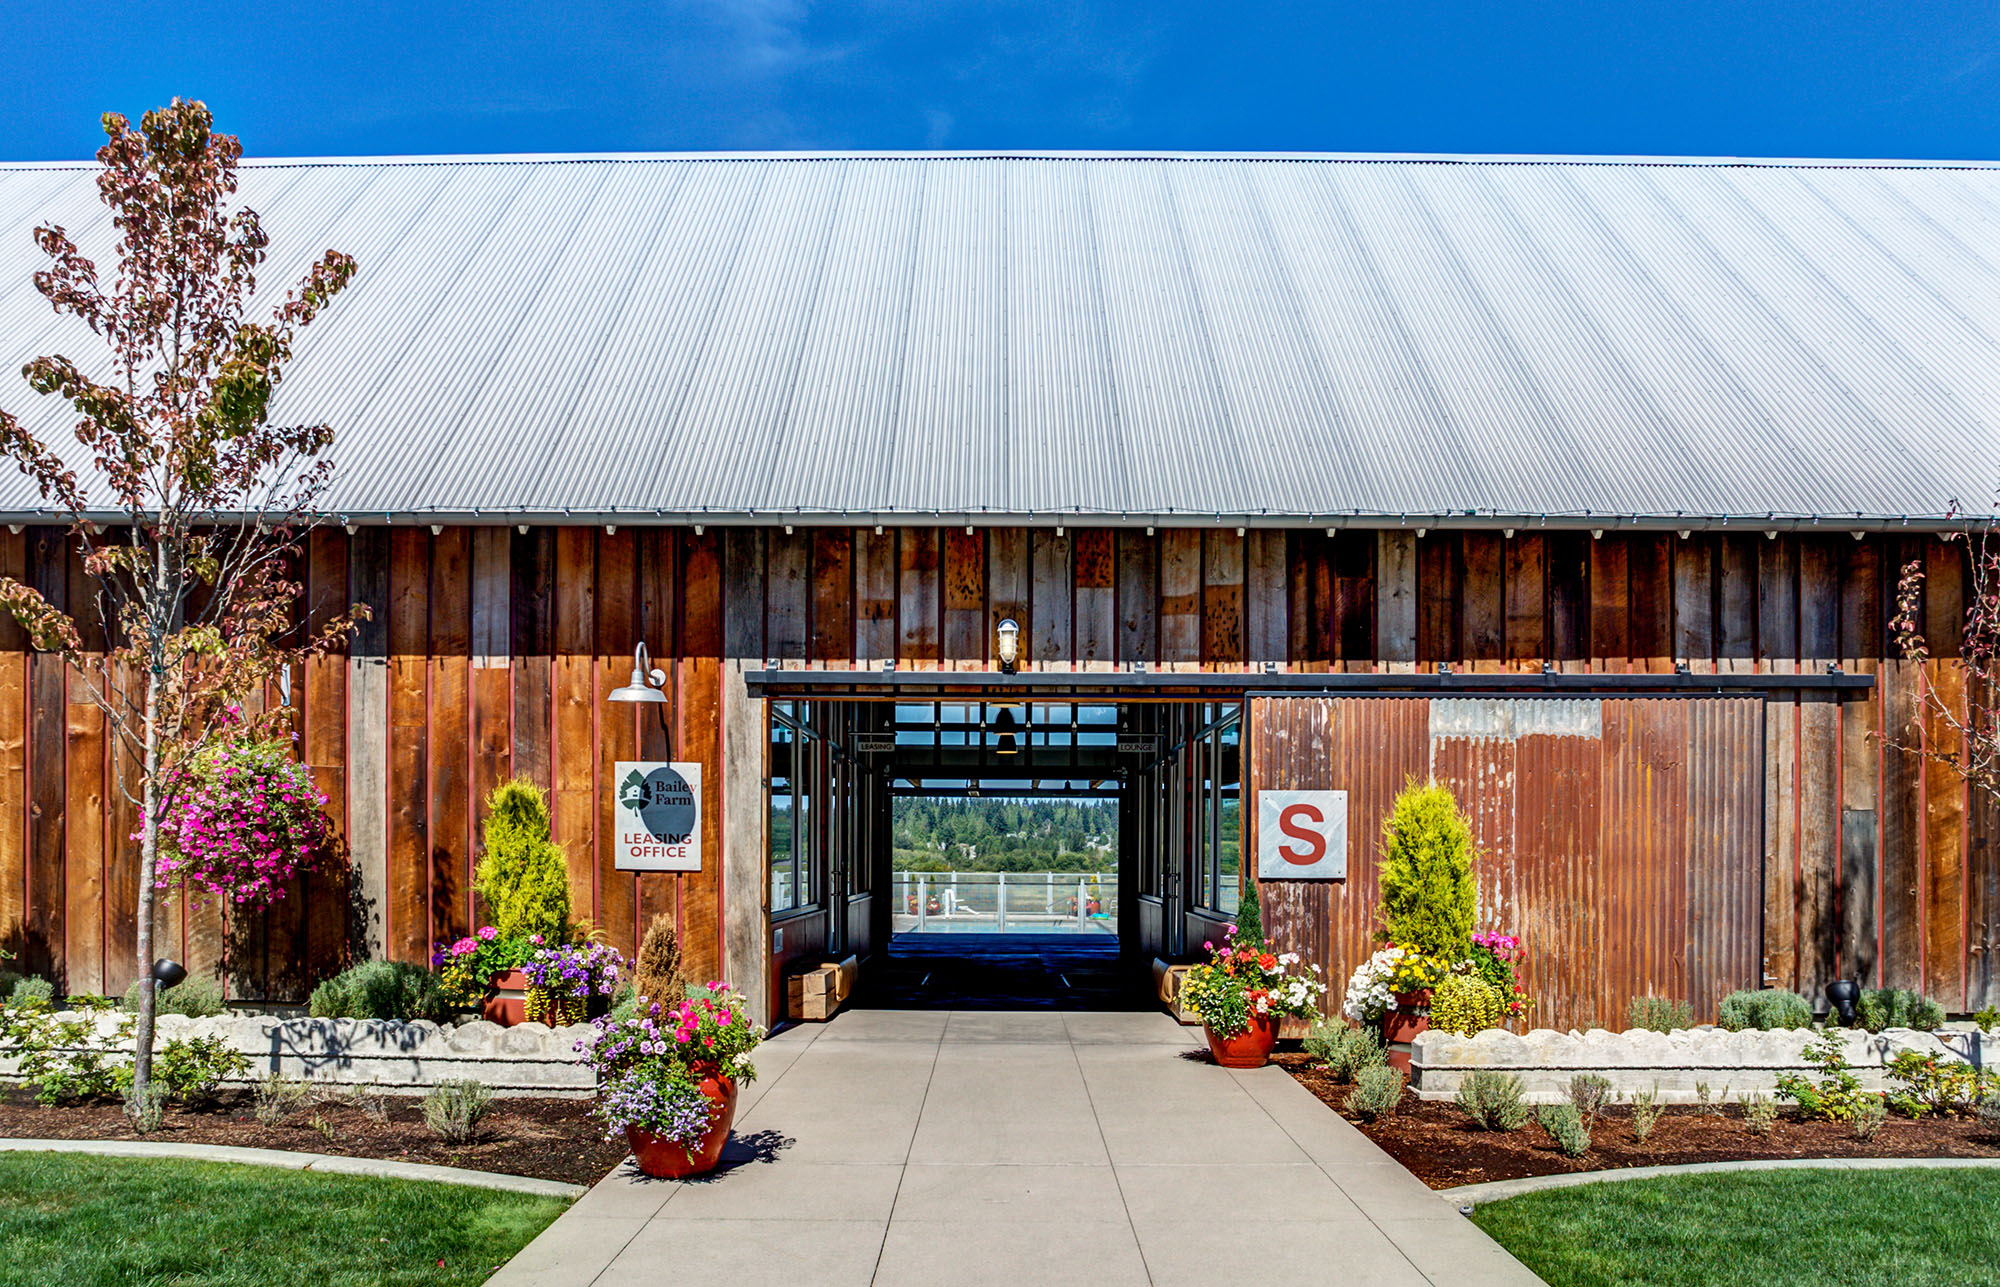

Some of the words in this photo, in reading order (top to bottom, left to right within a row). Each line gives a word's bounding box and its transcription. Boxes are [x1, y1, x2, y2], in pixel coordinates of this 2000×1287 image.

[656, 781, 697, 795] Bailey
[656, 794, 691, 806] Farm
[624, 833, 692, 845] LEASING
[1278, 803, 1327, 866] S
[630, 846, 687, 858] OFFICE
